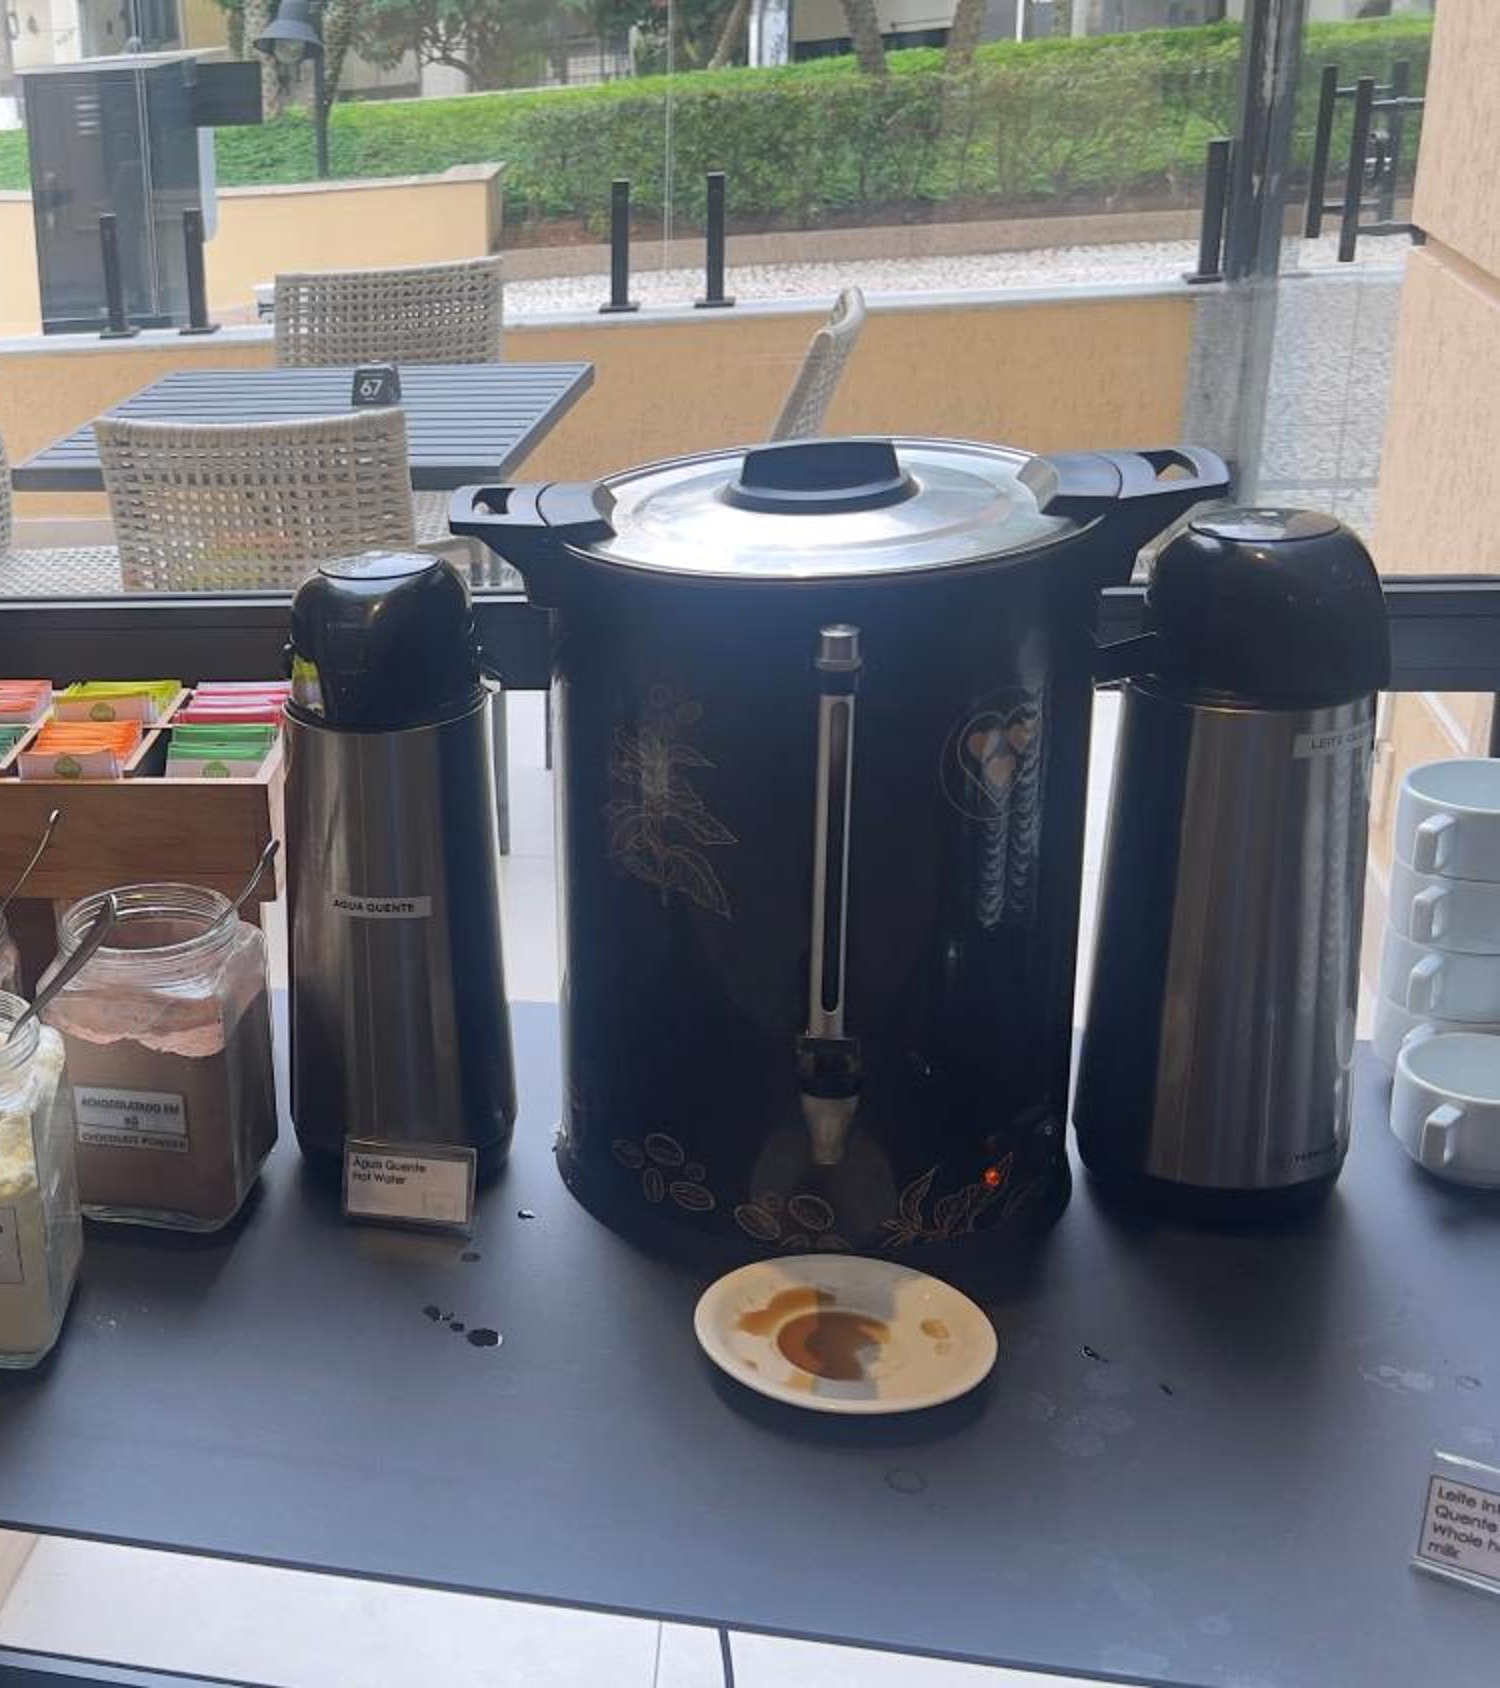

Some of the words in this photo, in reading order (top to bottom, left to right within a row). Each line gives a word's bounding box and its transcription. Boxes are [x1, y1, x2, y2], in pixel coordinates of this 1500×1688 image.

[360, 379, 382, 397] 67
[365, 903, 415, 913] QUENTE
[163, 1103, 180, 1115] EM
[1437, 1485, 1477, 1509] Leite
[1435, 1505, 1498, 1533] Quente
[1433, 1521, 1483, 1548] Whole
[1428, 1541, 1460, 1559] milk
